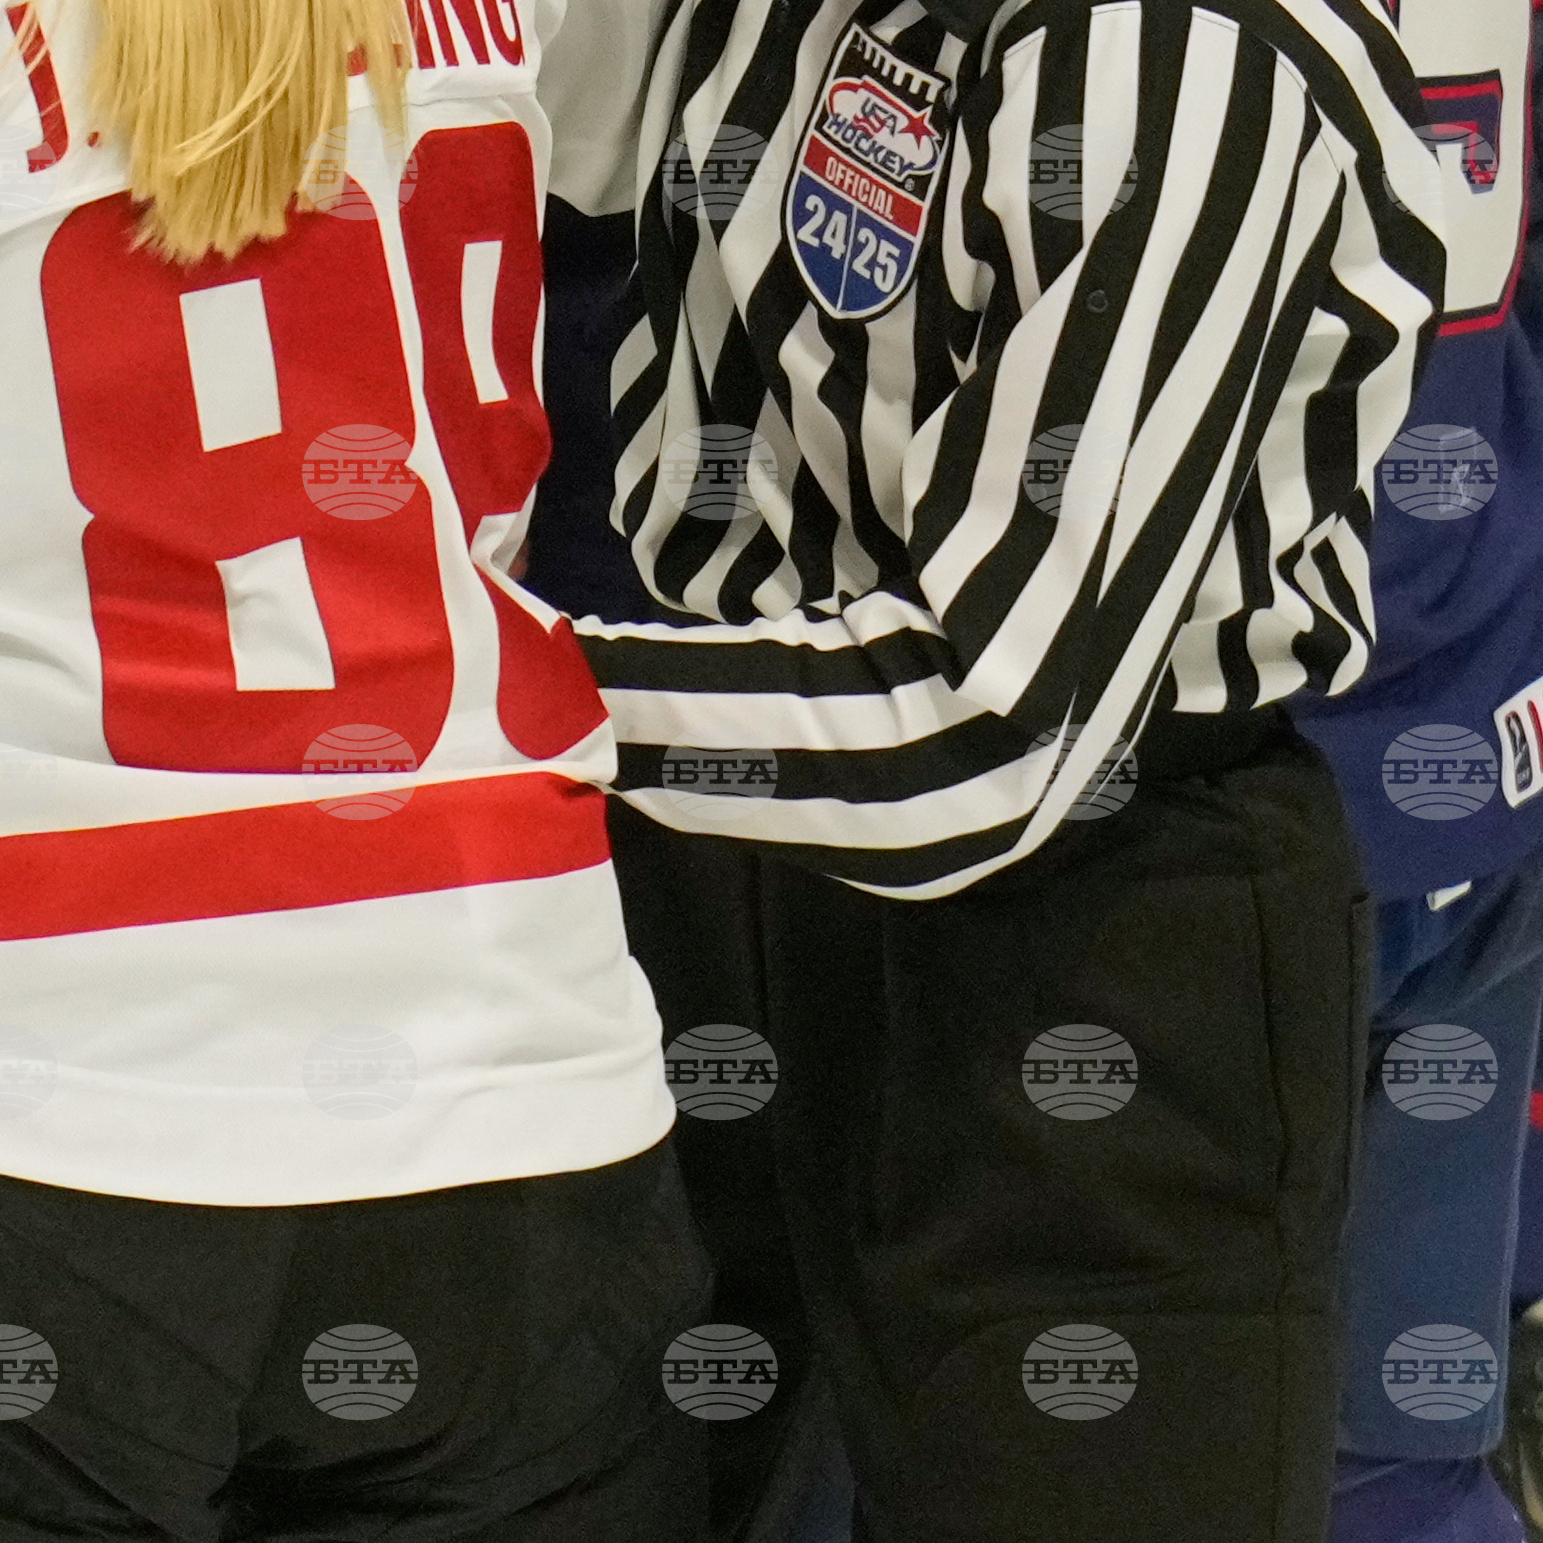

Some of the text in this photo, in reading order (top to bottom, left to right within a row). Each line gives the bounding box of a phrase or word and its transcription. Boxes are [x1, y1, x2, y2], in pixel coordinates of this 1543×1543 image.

[825, 112, 915, 179] HOCKEY
[824, 155, 895, 221] OFFICIAL
[796, 193, 901, 294] 24 25
[40, 120, 612, 774] 88
